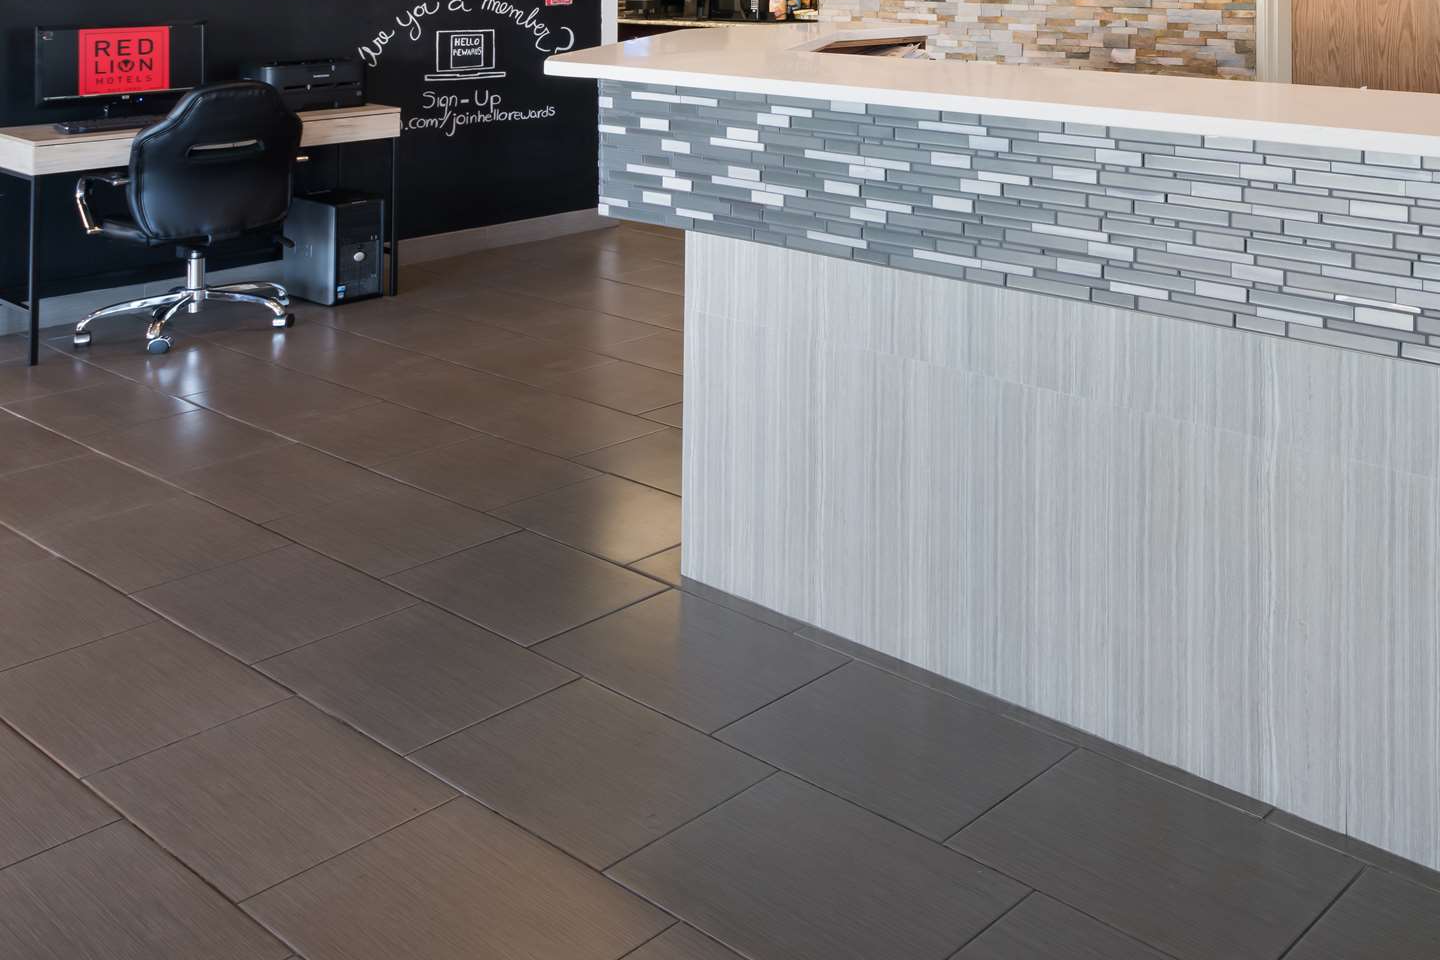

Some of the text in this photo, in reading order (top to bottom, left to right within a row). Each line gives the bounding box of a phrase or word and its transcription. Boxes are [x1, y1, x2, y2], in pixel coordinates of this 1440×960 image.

[396, 1, 440, 41] you
[95, 38, 154, 57] RED
[453, 37, 481, 47] HELLO
[95, 58, 153, 74] LION
[95, 76, 153, 85] HOTELS
